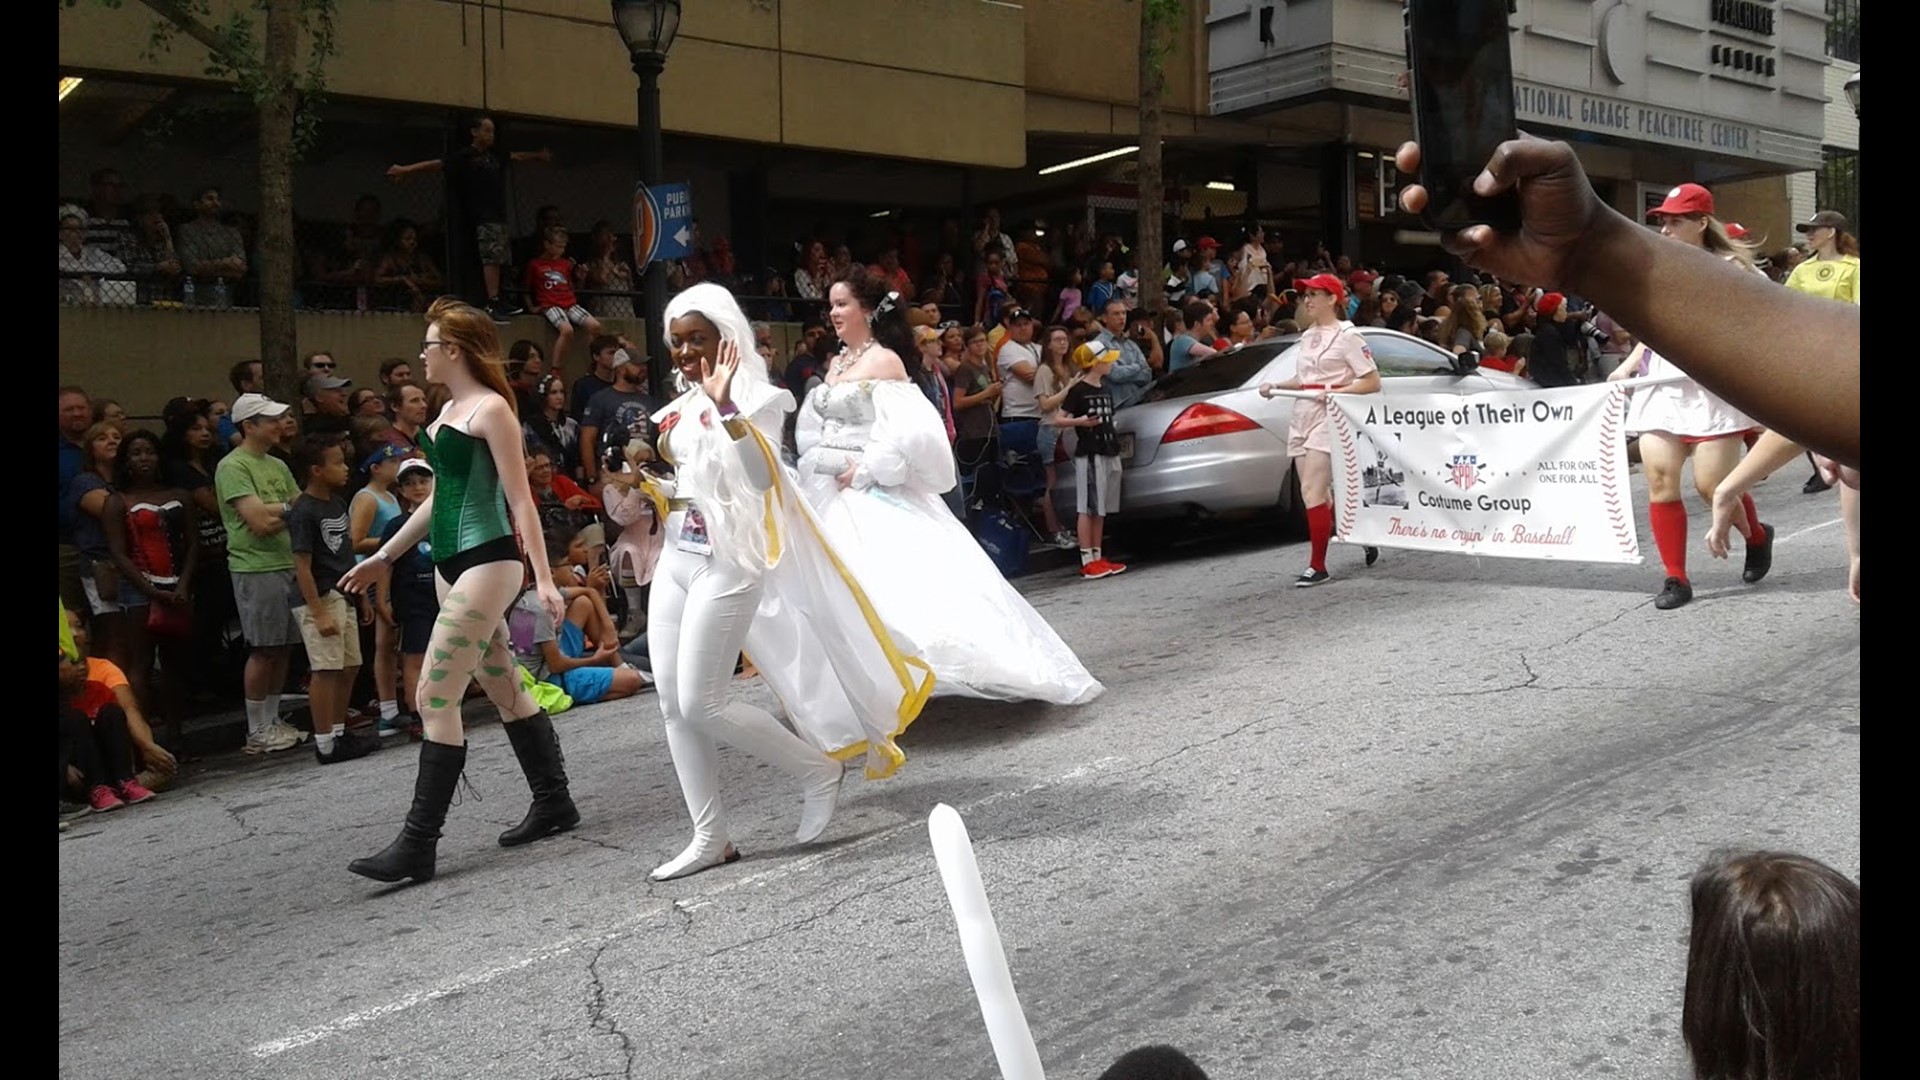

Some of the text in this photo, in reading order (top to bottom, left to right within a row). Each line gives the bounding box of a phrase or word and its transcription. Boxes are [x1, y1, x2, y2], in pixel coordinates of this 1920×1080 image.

[1513, 85, 1749, 151] ATIONAL GARAGE PEACHTREE CENTER
[1365, 400, 1573, 430] A League of Their Own
[1537, 461, 1597, 471] ALL FOR ONE
[1539, 474, 1599, 484] ONE FOR ALL
[1418, 491, 1531, 515] Costume Group
[1388, 517, 1576, 546] There's no cryin' in Baseball
